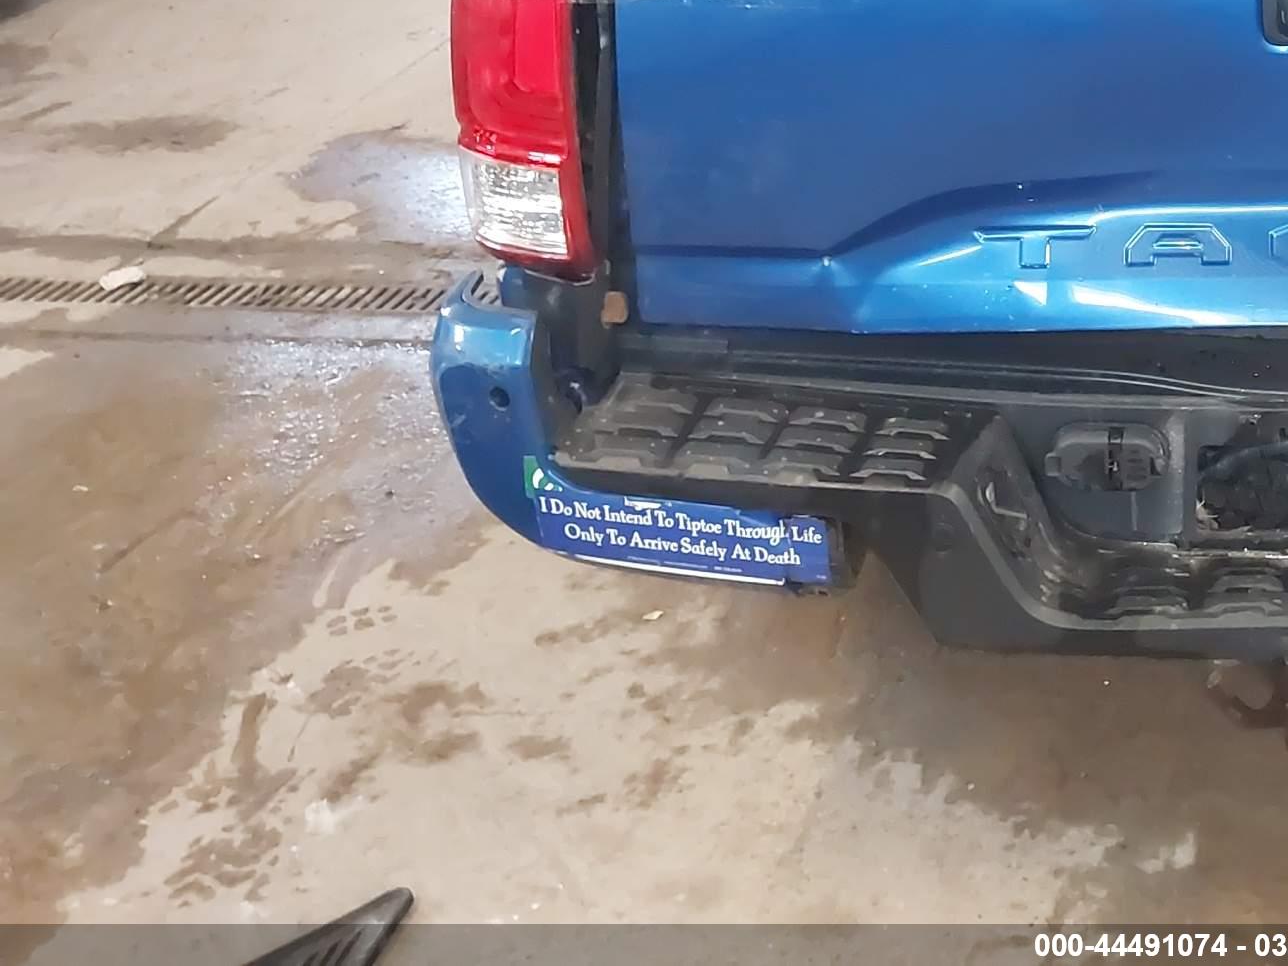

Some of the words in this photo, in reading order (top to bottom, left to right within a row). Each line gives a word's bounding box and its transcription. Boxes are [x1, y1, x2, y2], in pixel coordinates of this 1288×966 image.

[539, 496, 549, 513] I
[550, 498, 573, 516] Do
[573, 501, 602, 521] Not
[603, 505, 653, 526] Intend
[654, 510, 675, 528] To
[675, 512, 723, 537] Tiptoe
[791, 525, 823, 544] Life
[564, 523, 604, 546] Only
[606, 528, 627, 545] To
[630, 531, 679, 552] Arrive
[680, 537, 727, 561] Safely
[731, 543, 752, 561] At
[753, 546, 801, 565] Death
